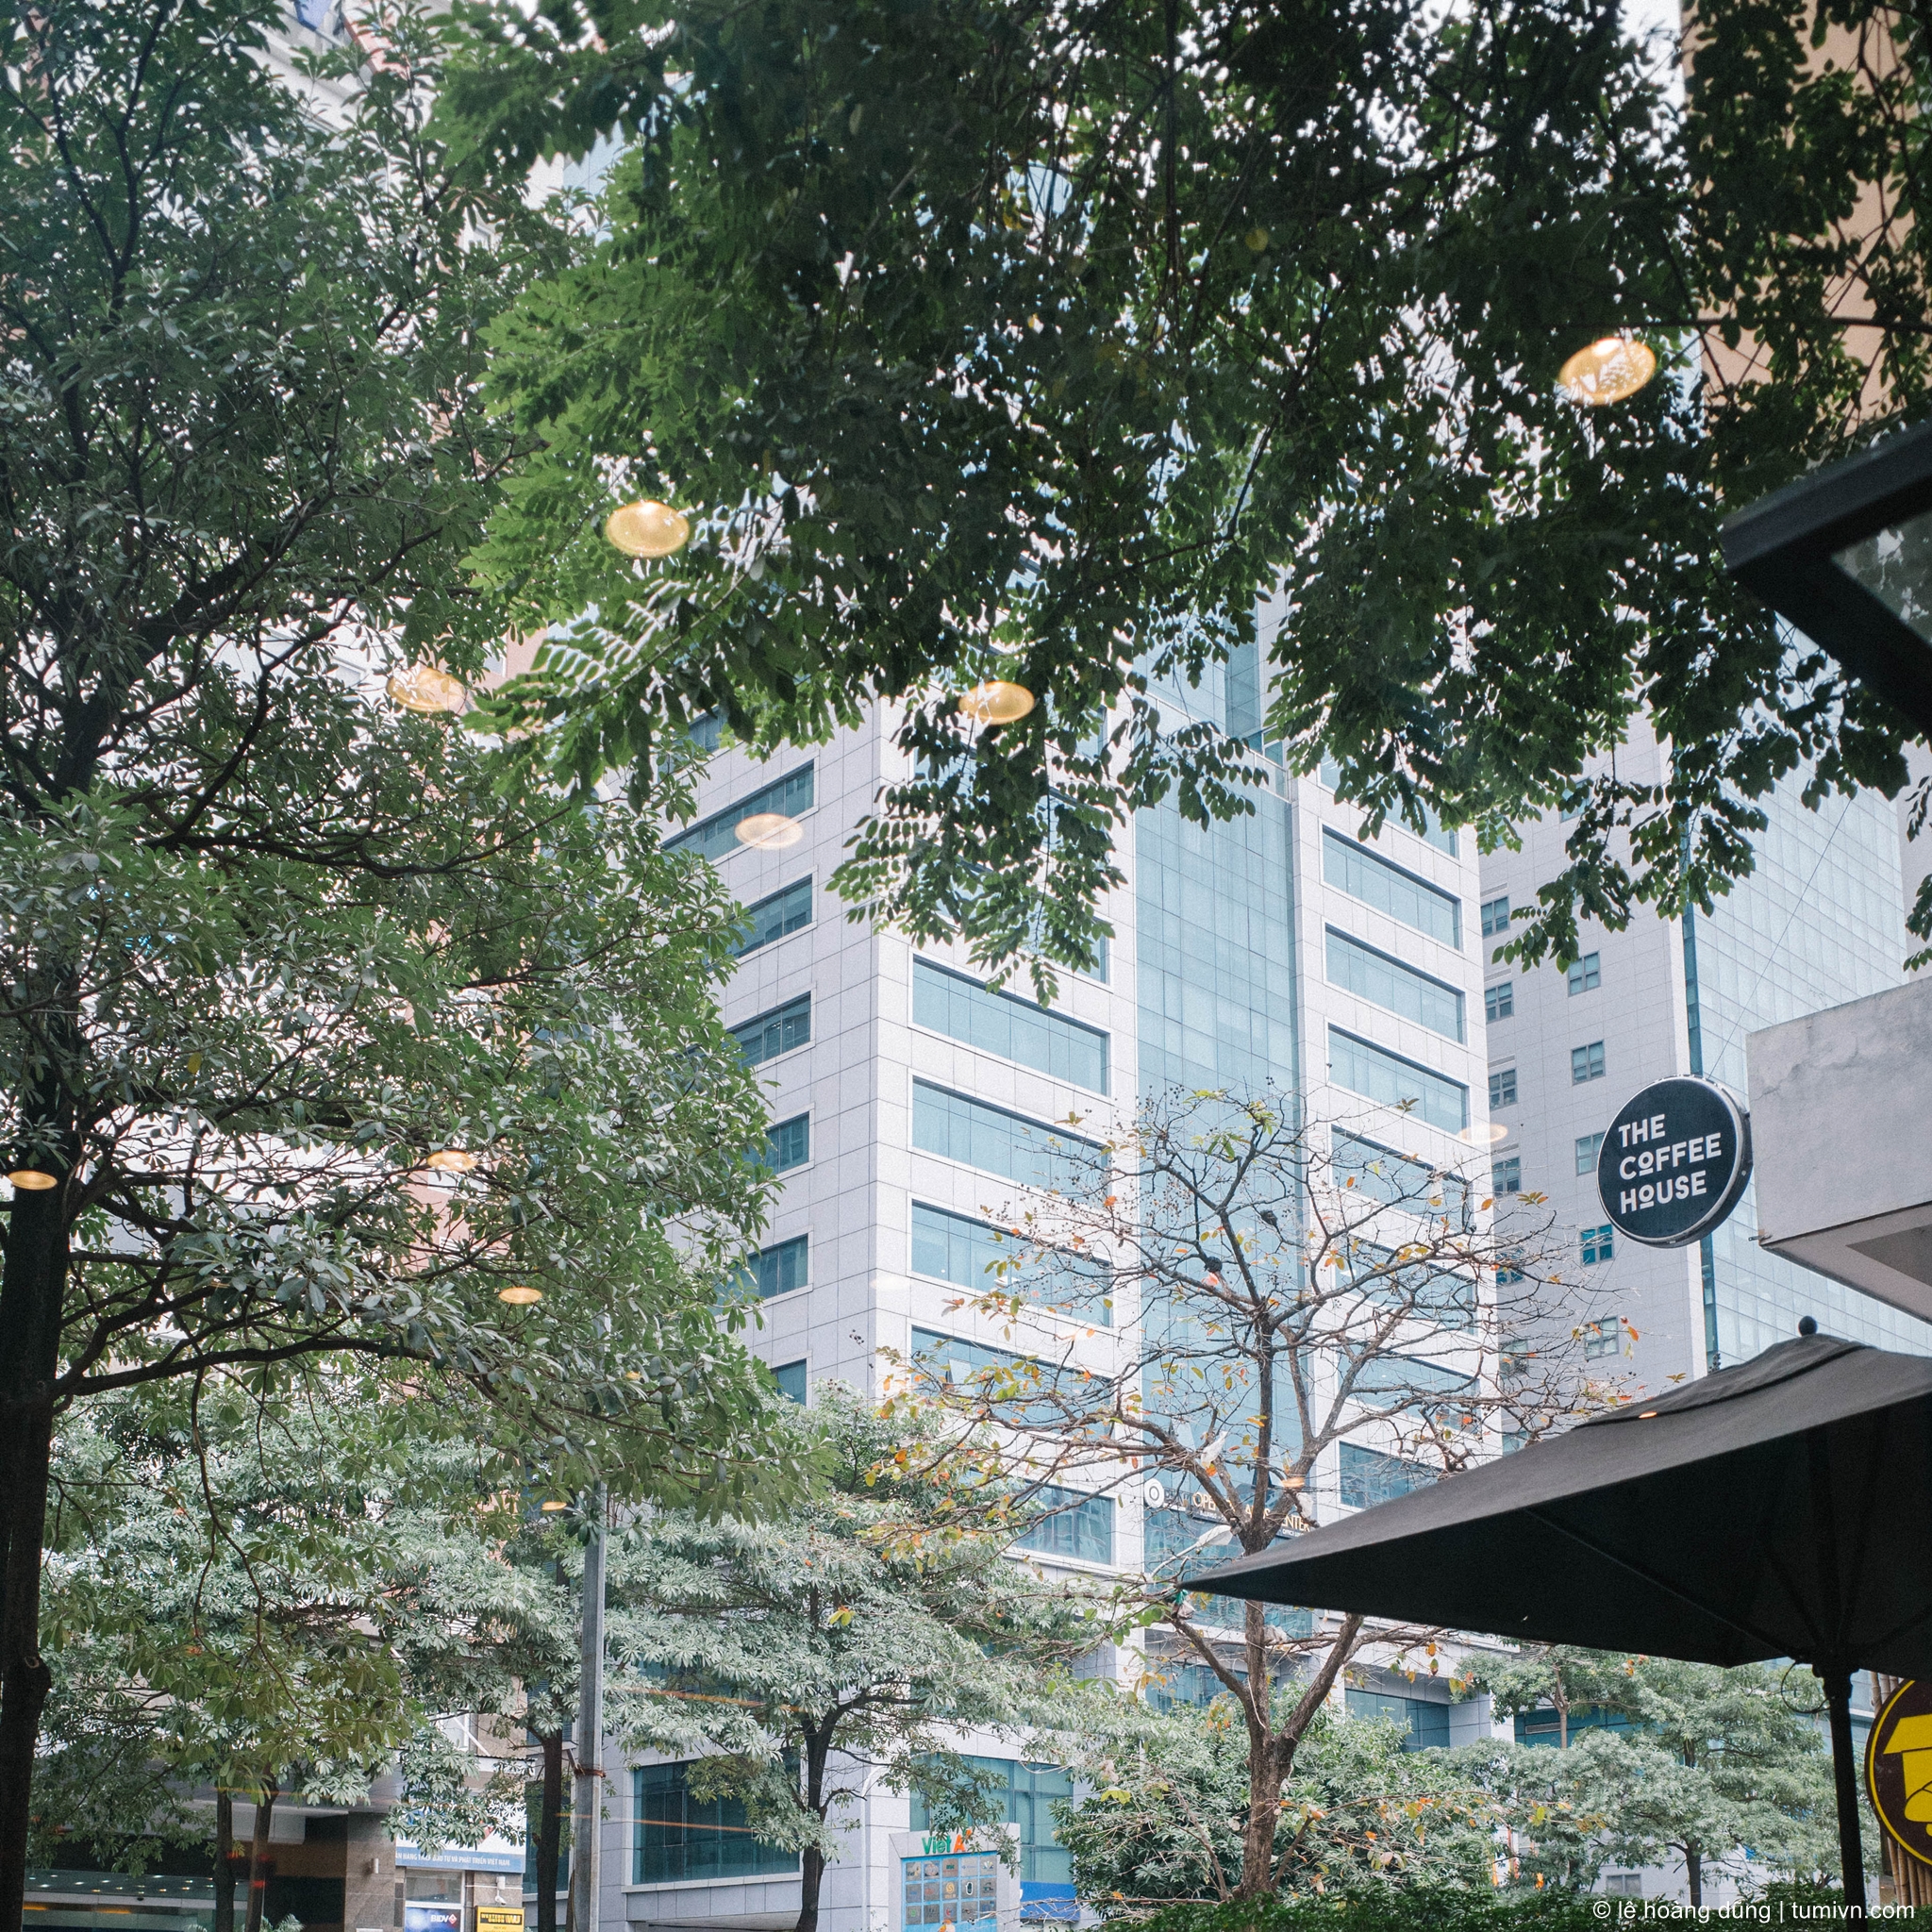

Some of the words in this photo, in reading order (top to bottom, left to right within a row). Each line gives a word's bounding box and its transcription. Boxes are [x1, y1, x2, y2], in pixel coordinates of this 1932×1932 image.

[1618, 1113, 1666, 1148] THE
[1620, 1132, 1722, 1180] COFFEE
[1621, 1170, 1707, 1214] HOUSE
[430, 1914, 449, 1923] BIDV
